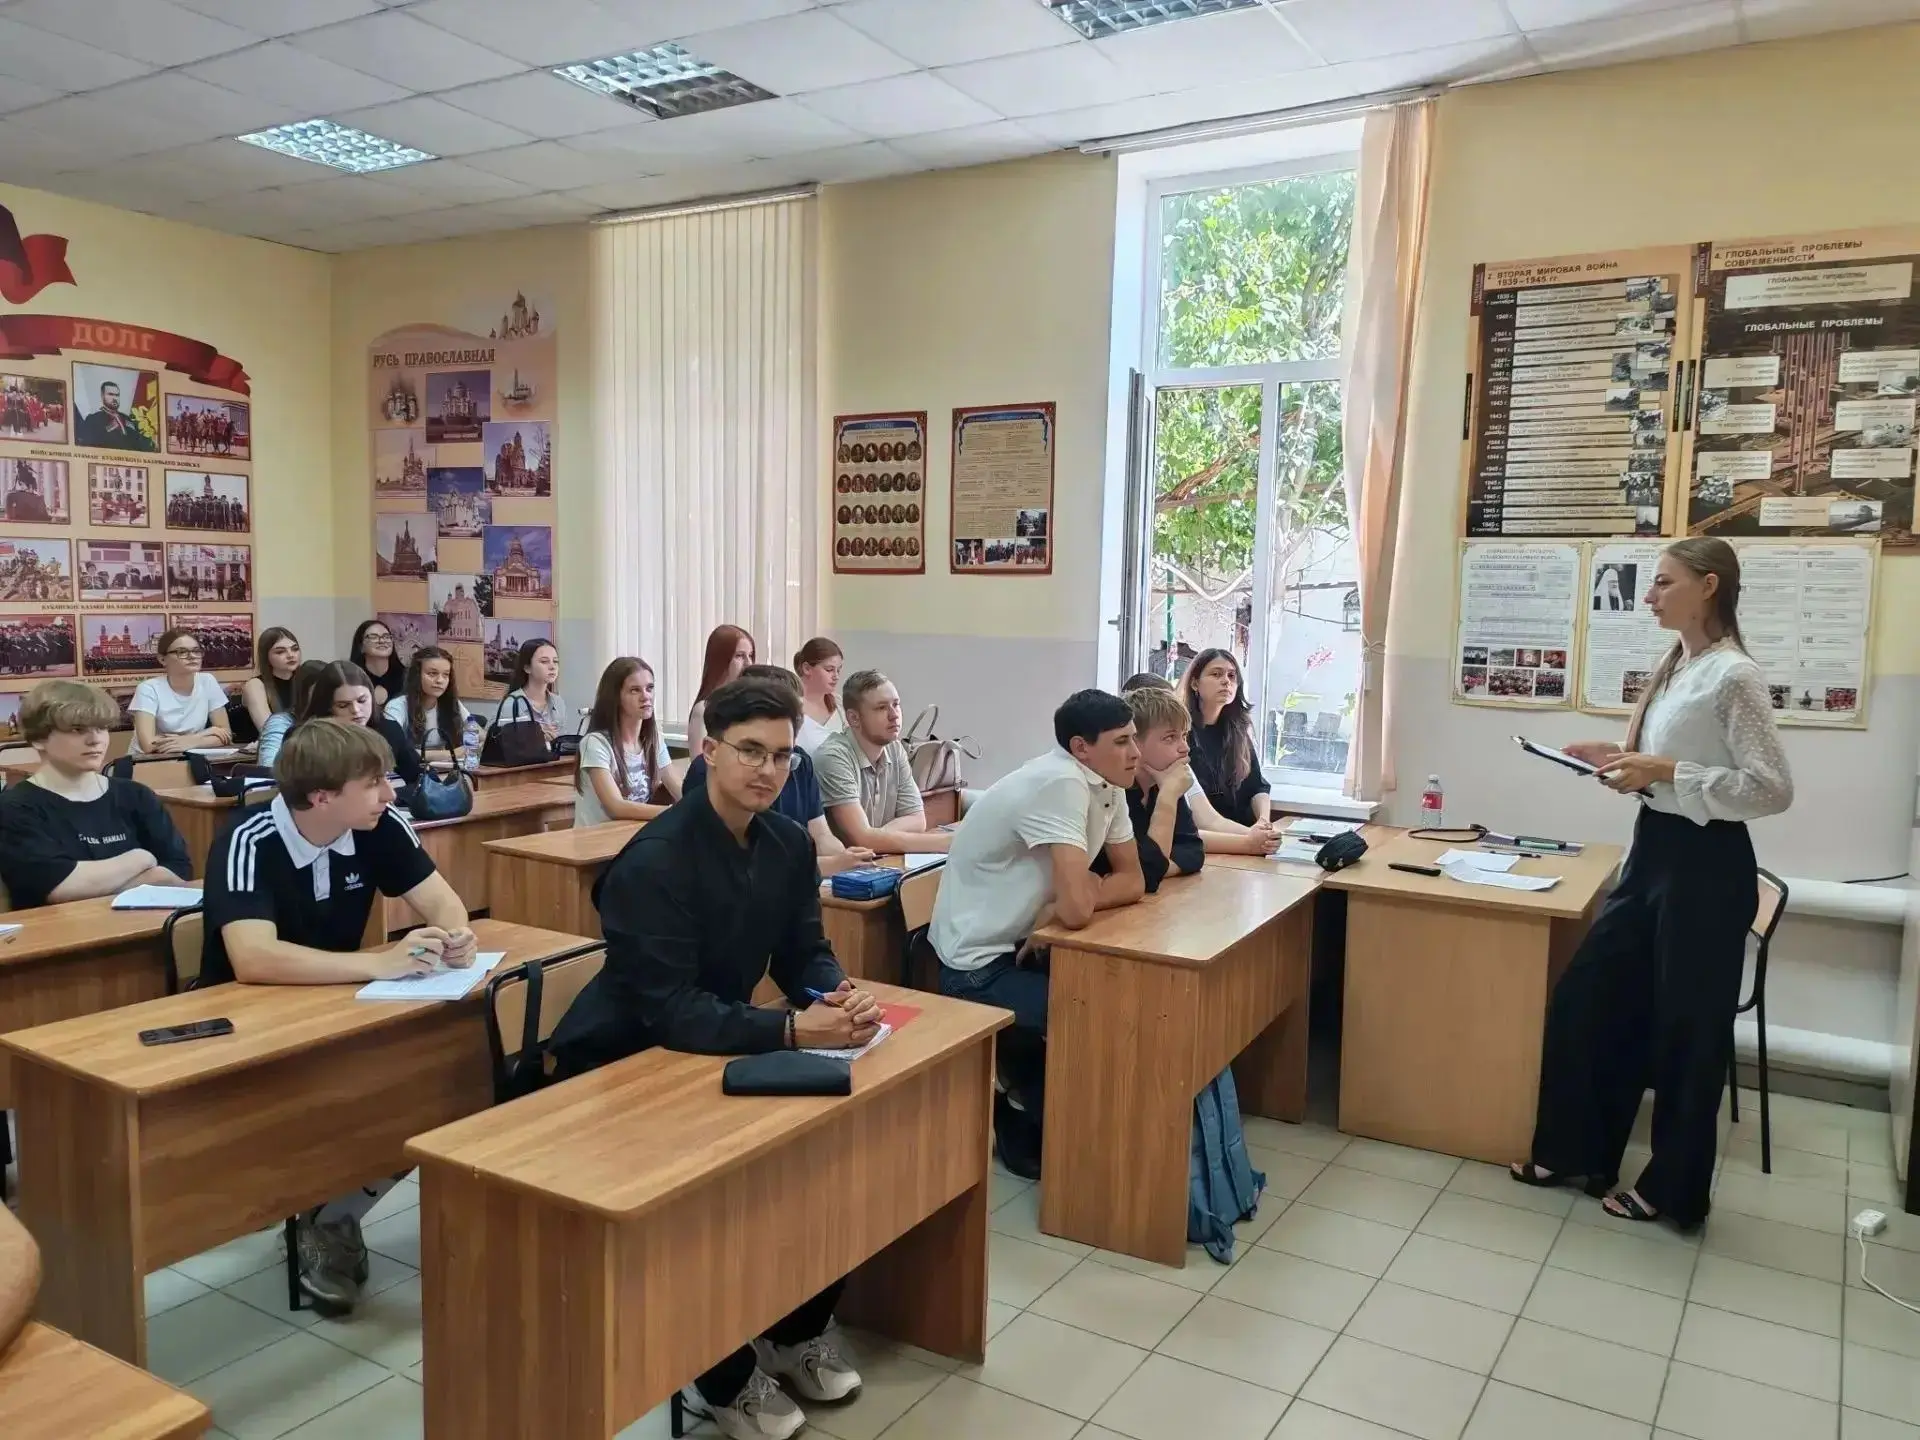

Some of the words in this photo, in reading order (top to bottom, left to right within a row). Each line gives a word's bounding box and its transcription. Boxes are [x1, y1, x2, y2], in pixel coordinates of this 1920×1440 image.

[1725, 246, 1795, 259] ГЛОБАЛЬНЫЕ
[1801, 240, 1863, 253] ПРОБЛЕМЫ
[1724, 253, 1815, 268] СОВРЕМЕННОСТИ
[1497, 269, 1531, 278] ВТОРАЯ
[1537, 265, 1581, 275] МИРОВАЯ
[1586, 261, 1618, 271] ВОЙНА
[1767, 273, 1819, 284] ГЛОБАЛЬНЫЕ
[1744, 320, 1816, 332] ГЛОБАЛЬНЫЕ
[1821, 317, 1884, 328] ПРОБЛЕМЫ
[373, 353, 399, 368] РУСЬ
[404, 348, 495, 366] ПРАВОСЛАВНАЯ
[343, 882, 364, 891] adidas
